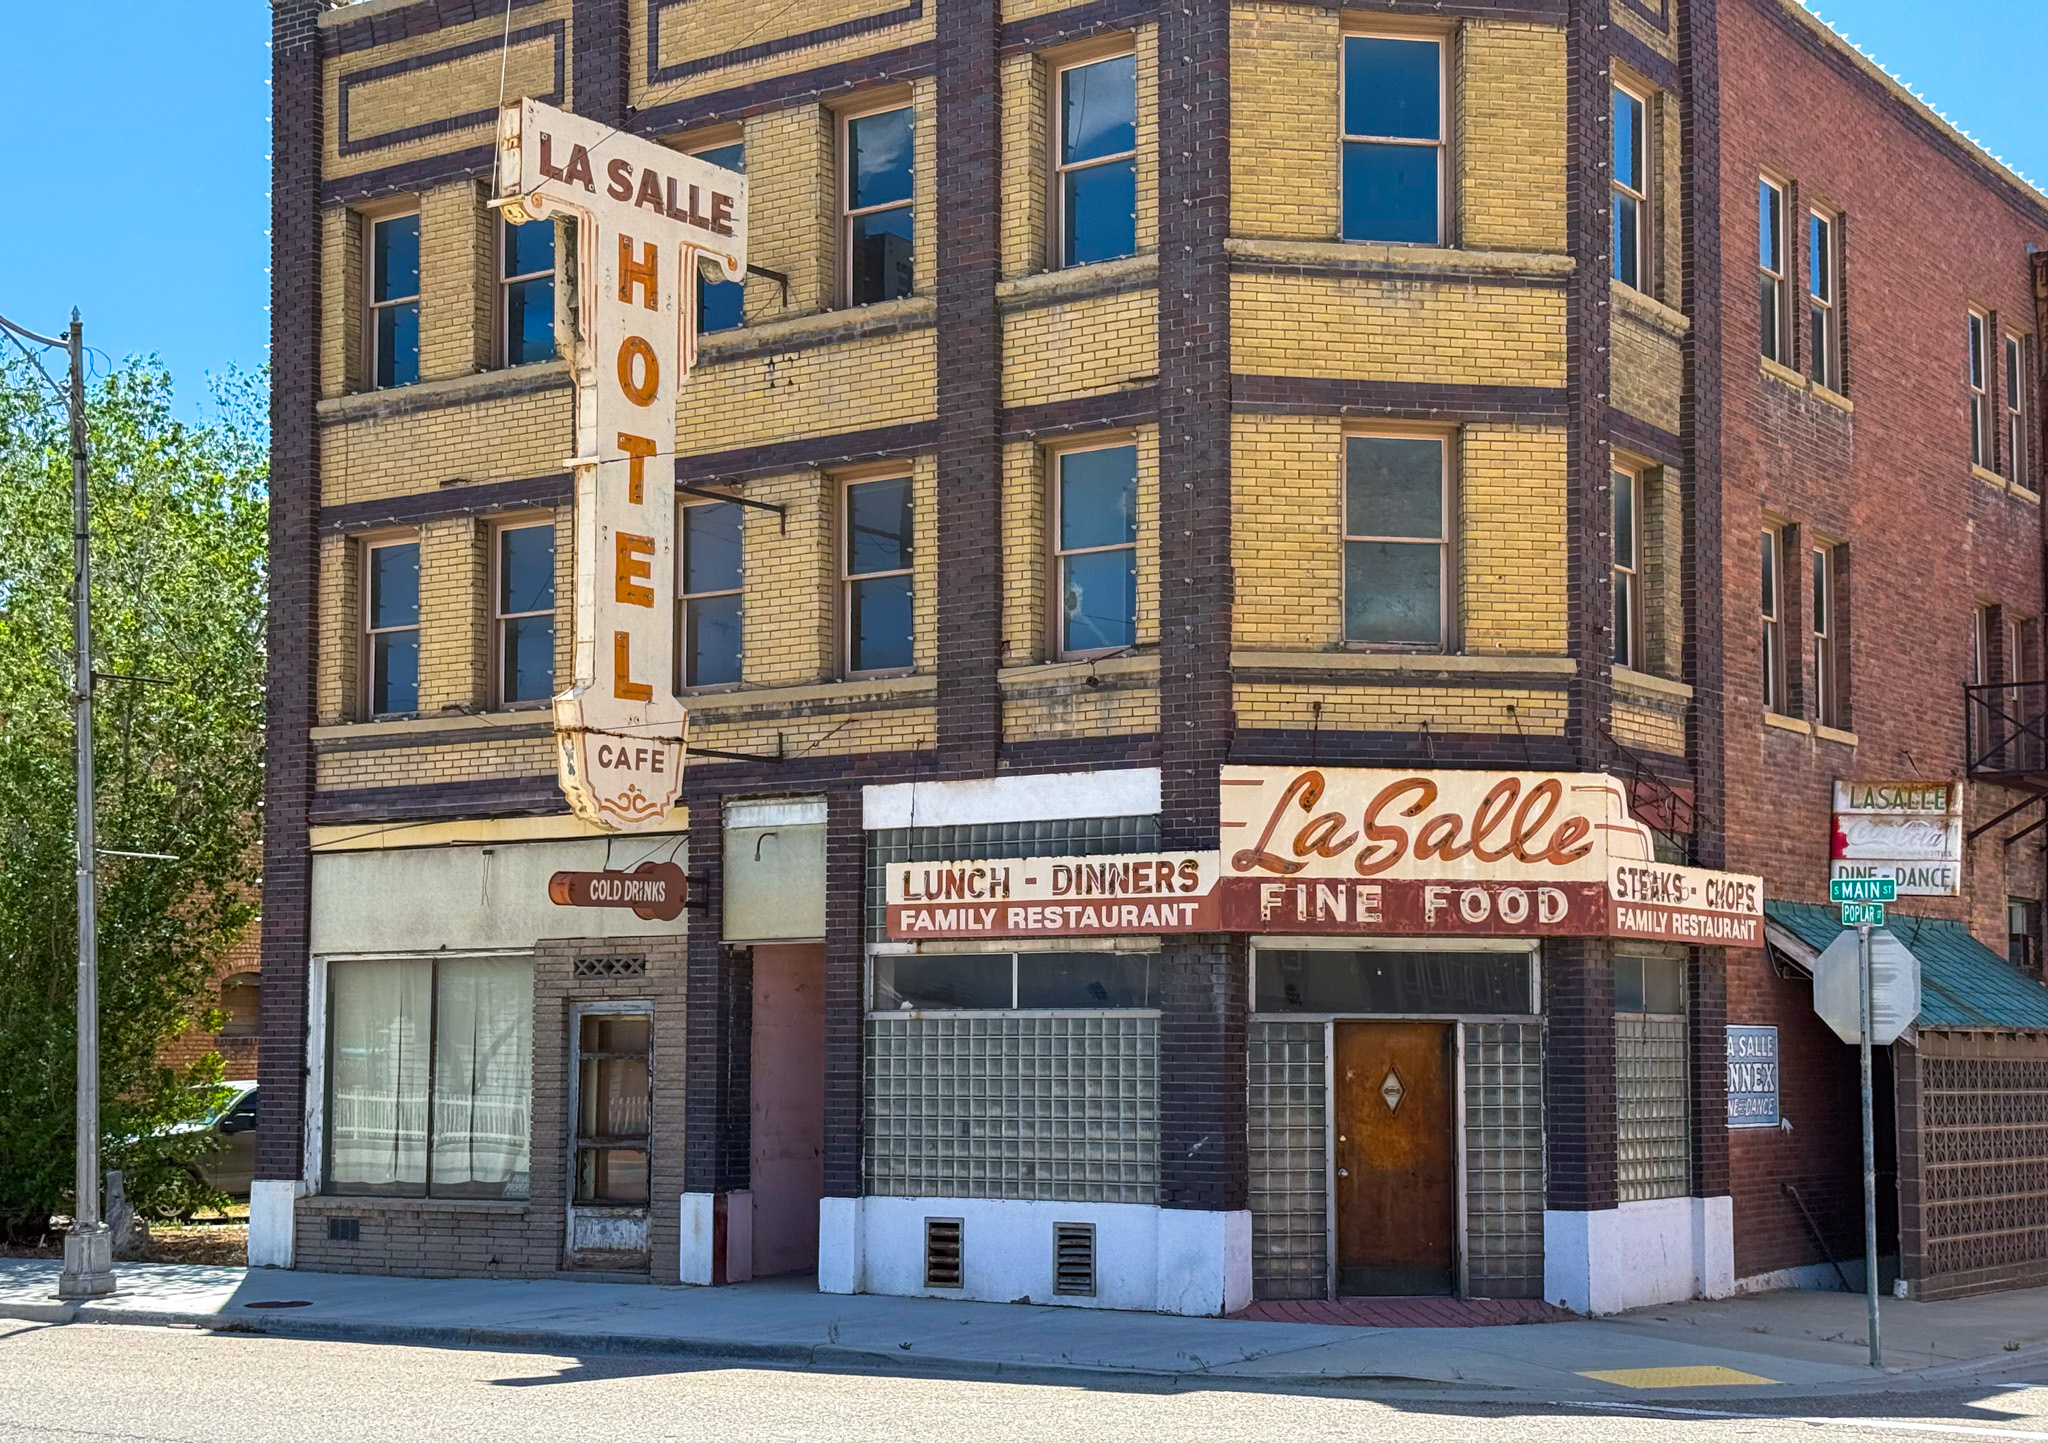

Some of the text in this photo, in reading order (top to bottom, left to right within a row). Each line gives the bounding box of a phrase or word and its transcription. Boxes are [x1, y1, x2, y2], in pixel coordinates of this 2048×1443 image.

[539, 130, 735, 238] LA SALLE
[613, 232, 660, 703] HOTEL
[598, 744, 665, 773] CAFE
[1850, 786, 1946, 810] LASALLE
[1231, 769, 1594, 877] LaSalle
[590, 879, 666, 902] COLD DRINKS
[902, 866, 1011, 902] LUNCH
[1051, 858, 1200, 898] DINNERS
[1616, 866, 1687, 905] STEAKS
[1705, 878, 1758, 913] CHOPS
[1833, 882, 1892, 899] S MAIN ST
[1895, 867, 1952, 888] DANCE
[900, 902, 1200, 932] FAMILY RESTAURANT
[1260, 883, 1569, 924] FINE FOOD
[1844, 904, 1875, 922] POPLAR
[1616, 907, 1757, 941] FAMILY RESTAURANT
[1726, 1035, 1774, 1057] A SALLE
[1727, 1062, 1776, 1093] NNEX
[1745, 1098, 1775, 1117] DANCE
